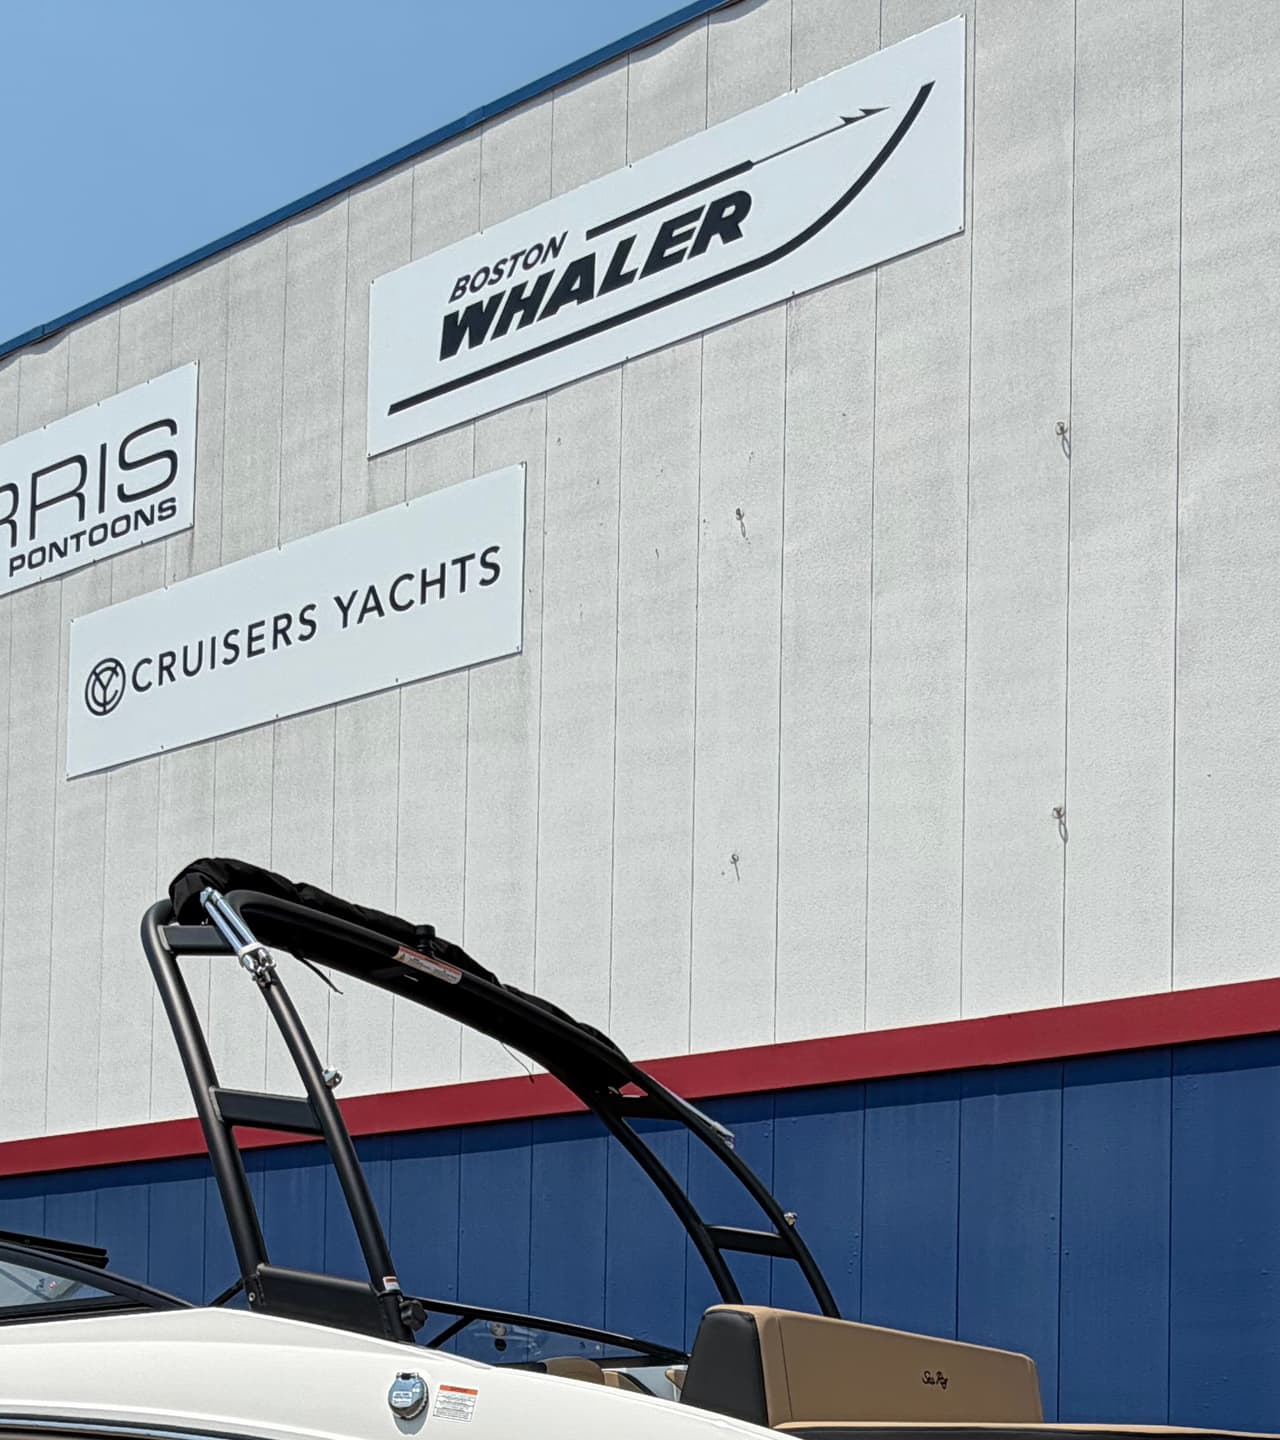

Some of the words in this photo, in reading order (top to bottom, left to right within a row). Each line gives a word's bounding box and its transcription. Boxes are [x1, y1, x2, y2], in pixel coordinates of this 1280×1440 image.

[439, 190, 752, 362] WHALER
[448, 230, 569, 304] BOSTON
[9, 497, 177, 577] PONTOONS
[131, 603, 318, 693] CRUISERS
[333, 545, 501, 629] YACHTS
